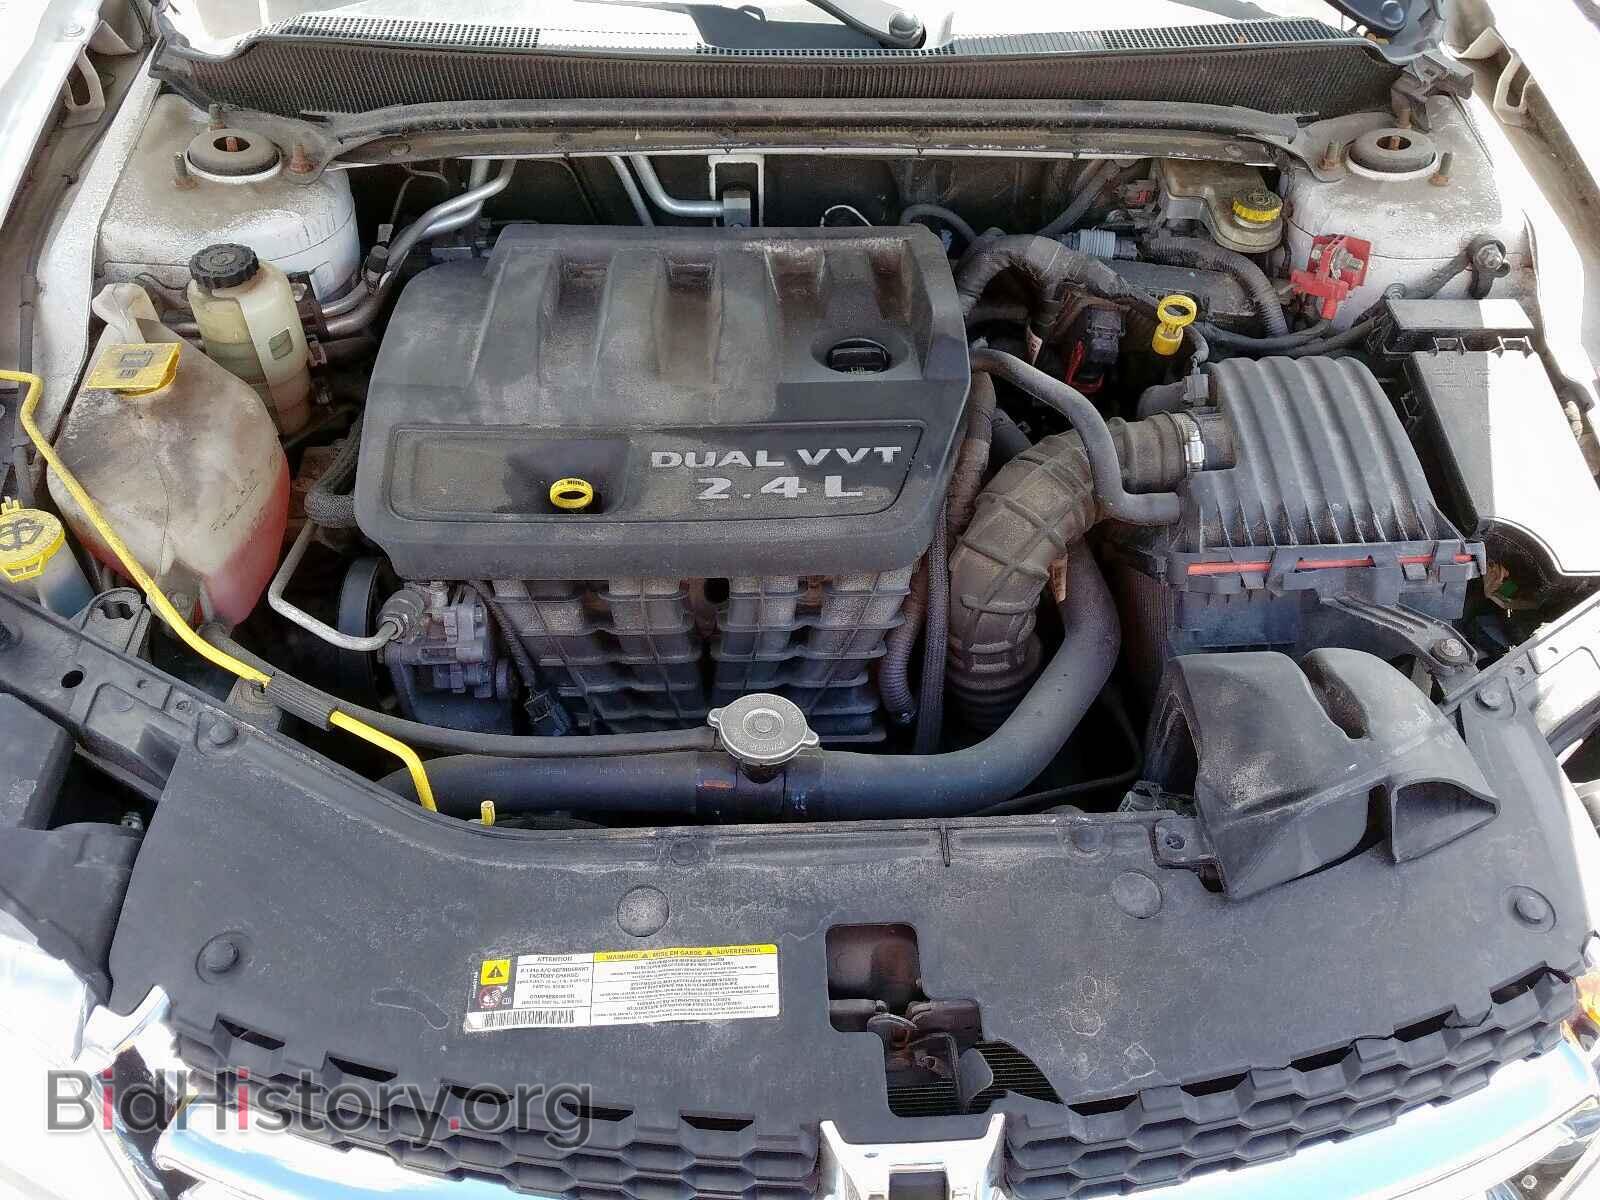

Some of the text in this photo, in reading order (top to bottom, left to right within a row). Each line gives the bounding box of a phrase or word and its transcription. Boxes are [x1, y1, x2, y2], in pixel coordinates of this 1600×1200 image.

[651, 446, 902, 468] DUAL VVT
[716, 947, 761, 955] ADVERTENCIA
[536, 955, 573, 963] ATTENTION
